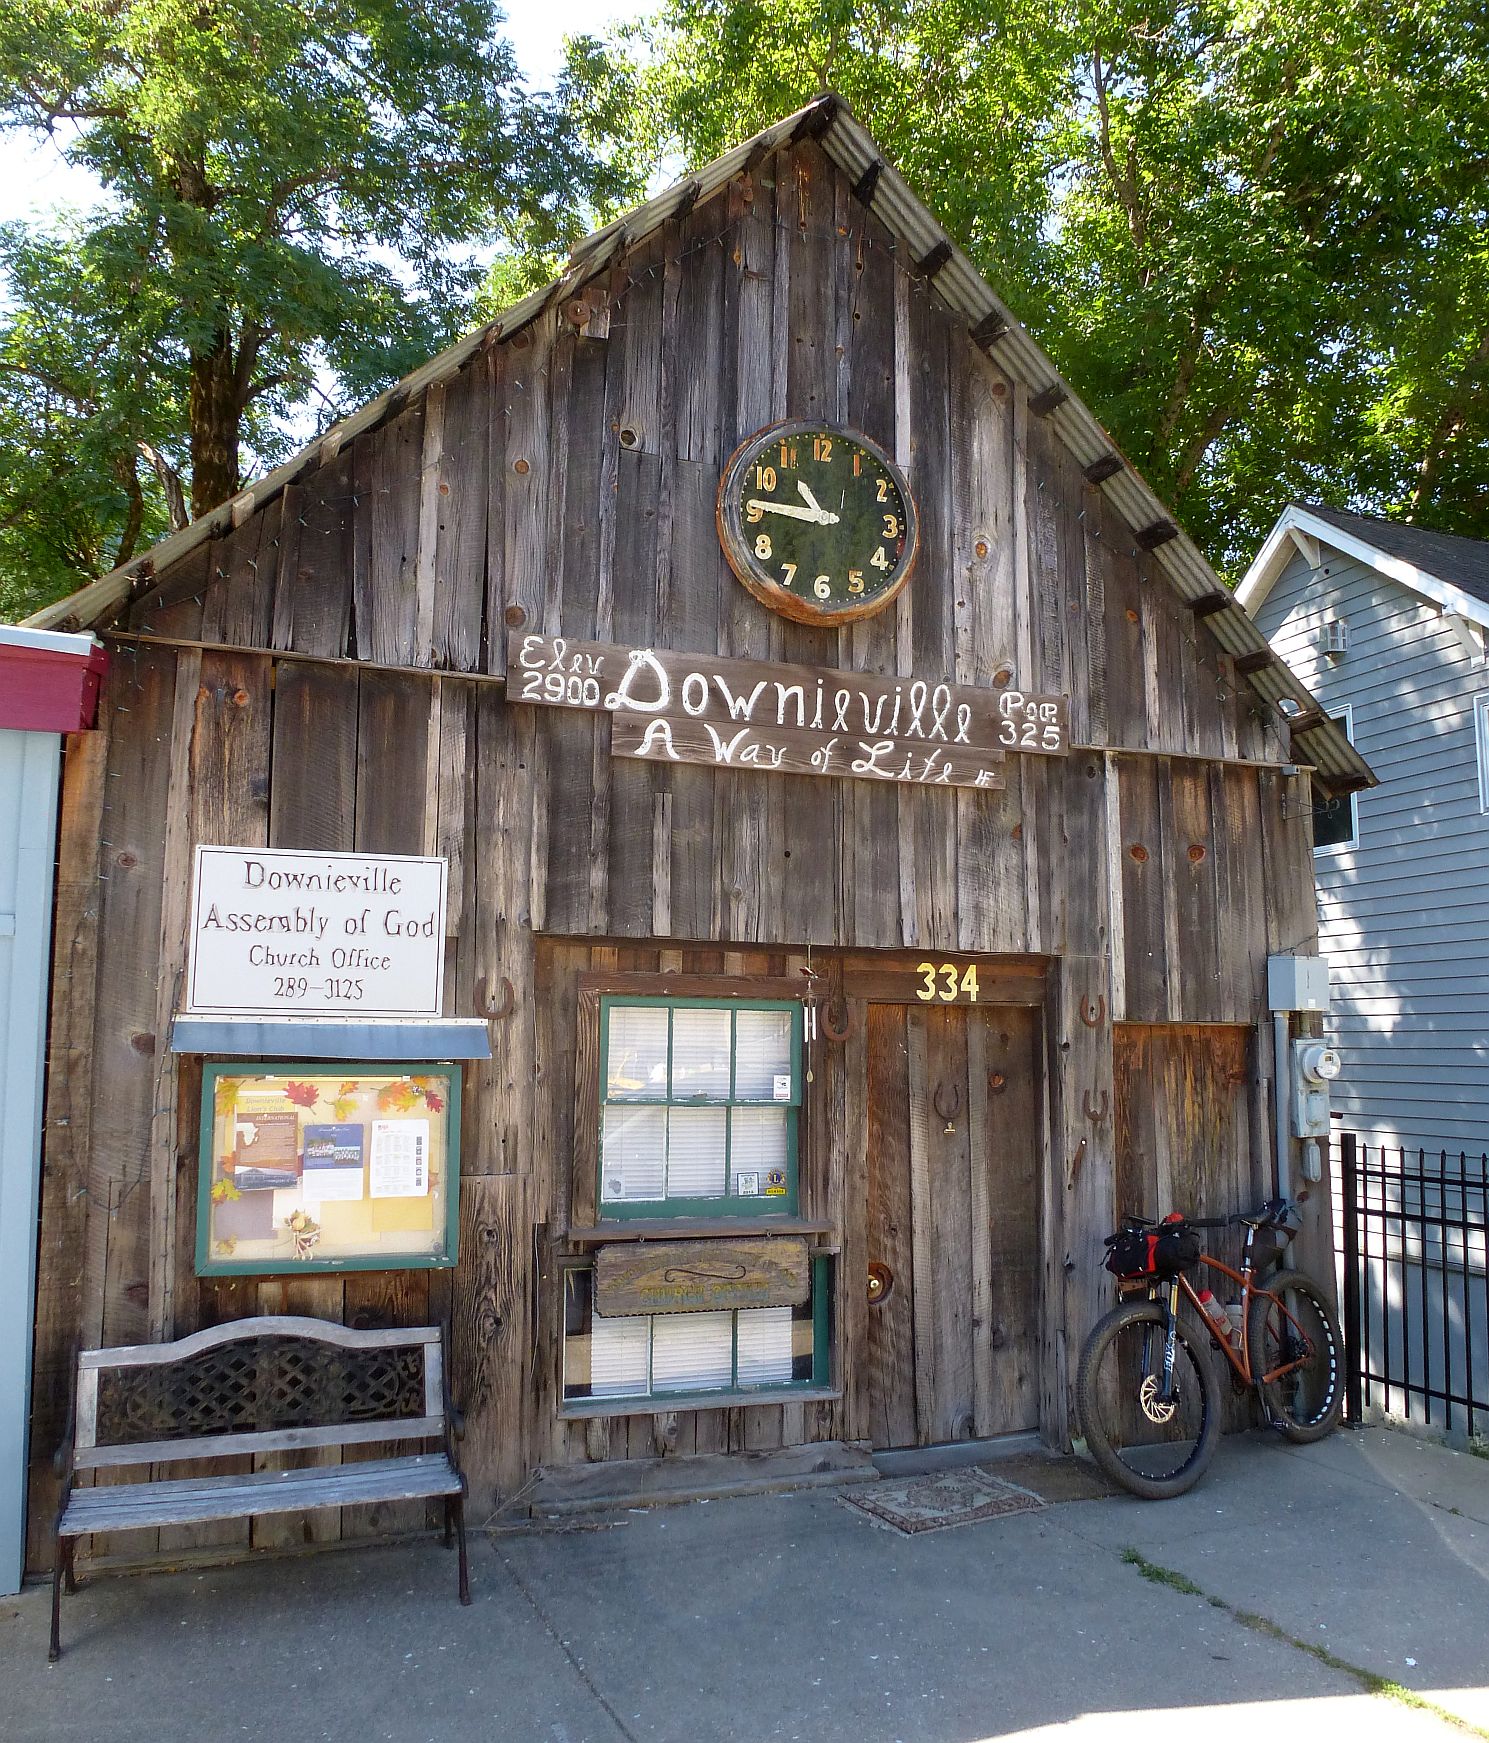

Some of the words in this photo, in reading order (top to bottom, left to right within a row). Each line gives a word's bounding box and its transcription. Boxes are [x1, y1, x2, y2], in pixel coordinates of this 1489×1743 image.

[780, 446, 798, 469] 11
[813, 439, 833, 462] 12
[853, 454, 862, 477] 1
[756, 466, 777, 492] 10
[876, 479, 888, 503] 2
[746, 499, 764, 523] 9
[882, 515, 898, 539] 3
[754, 534, 772, 560] 8
[870, 546, 889, 571] 4
[780, 563, 797, 586] 7
[813, 575, 831, 599] 6
[848, 570, 865, 593] 5
[519, 635, 604, 674] Elev
[521, 671, 600, 706] 2900
[604, 648, 971, 744] Downieville
[999, 720, 1061, 750] 325
[634, 718, 680, 760] A
[703, 723, 787, 769] Way
[810, 738, 838, 773] of
[851, 740, 953, 783] Life
[243, 860, 402, 895] Downieville
[201, 903, 329, 941] Assembly
[344, 908, 371, 935] of
[384, 909, 435, 938] God
[249, 944, 321, 968] Church
[331, 948, 391, 970] Office
[273, 977, 364, 1000] 289-3125
[916, 962, 979, 1002] 334
